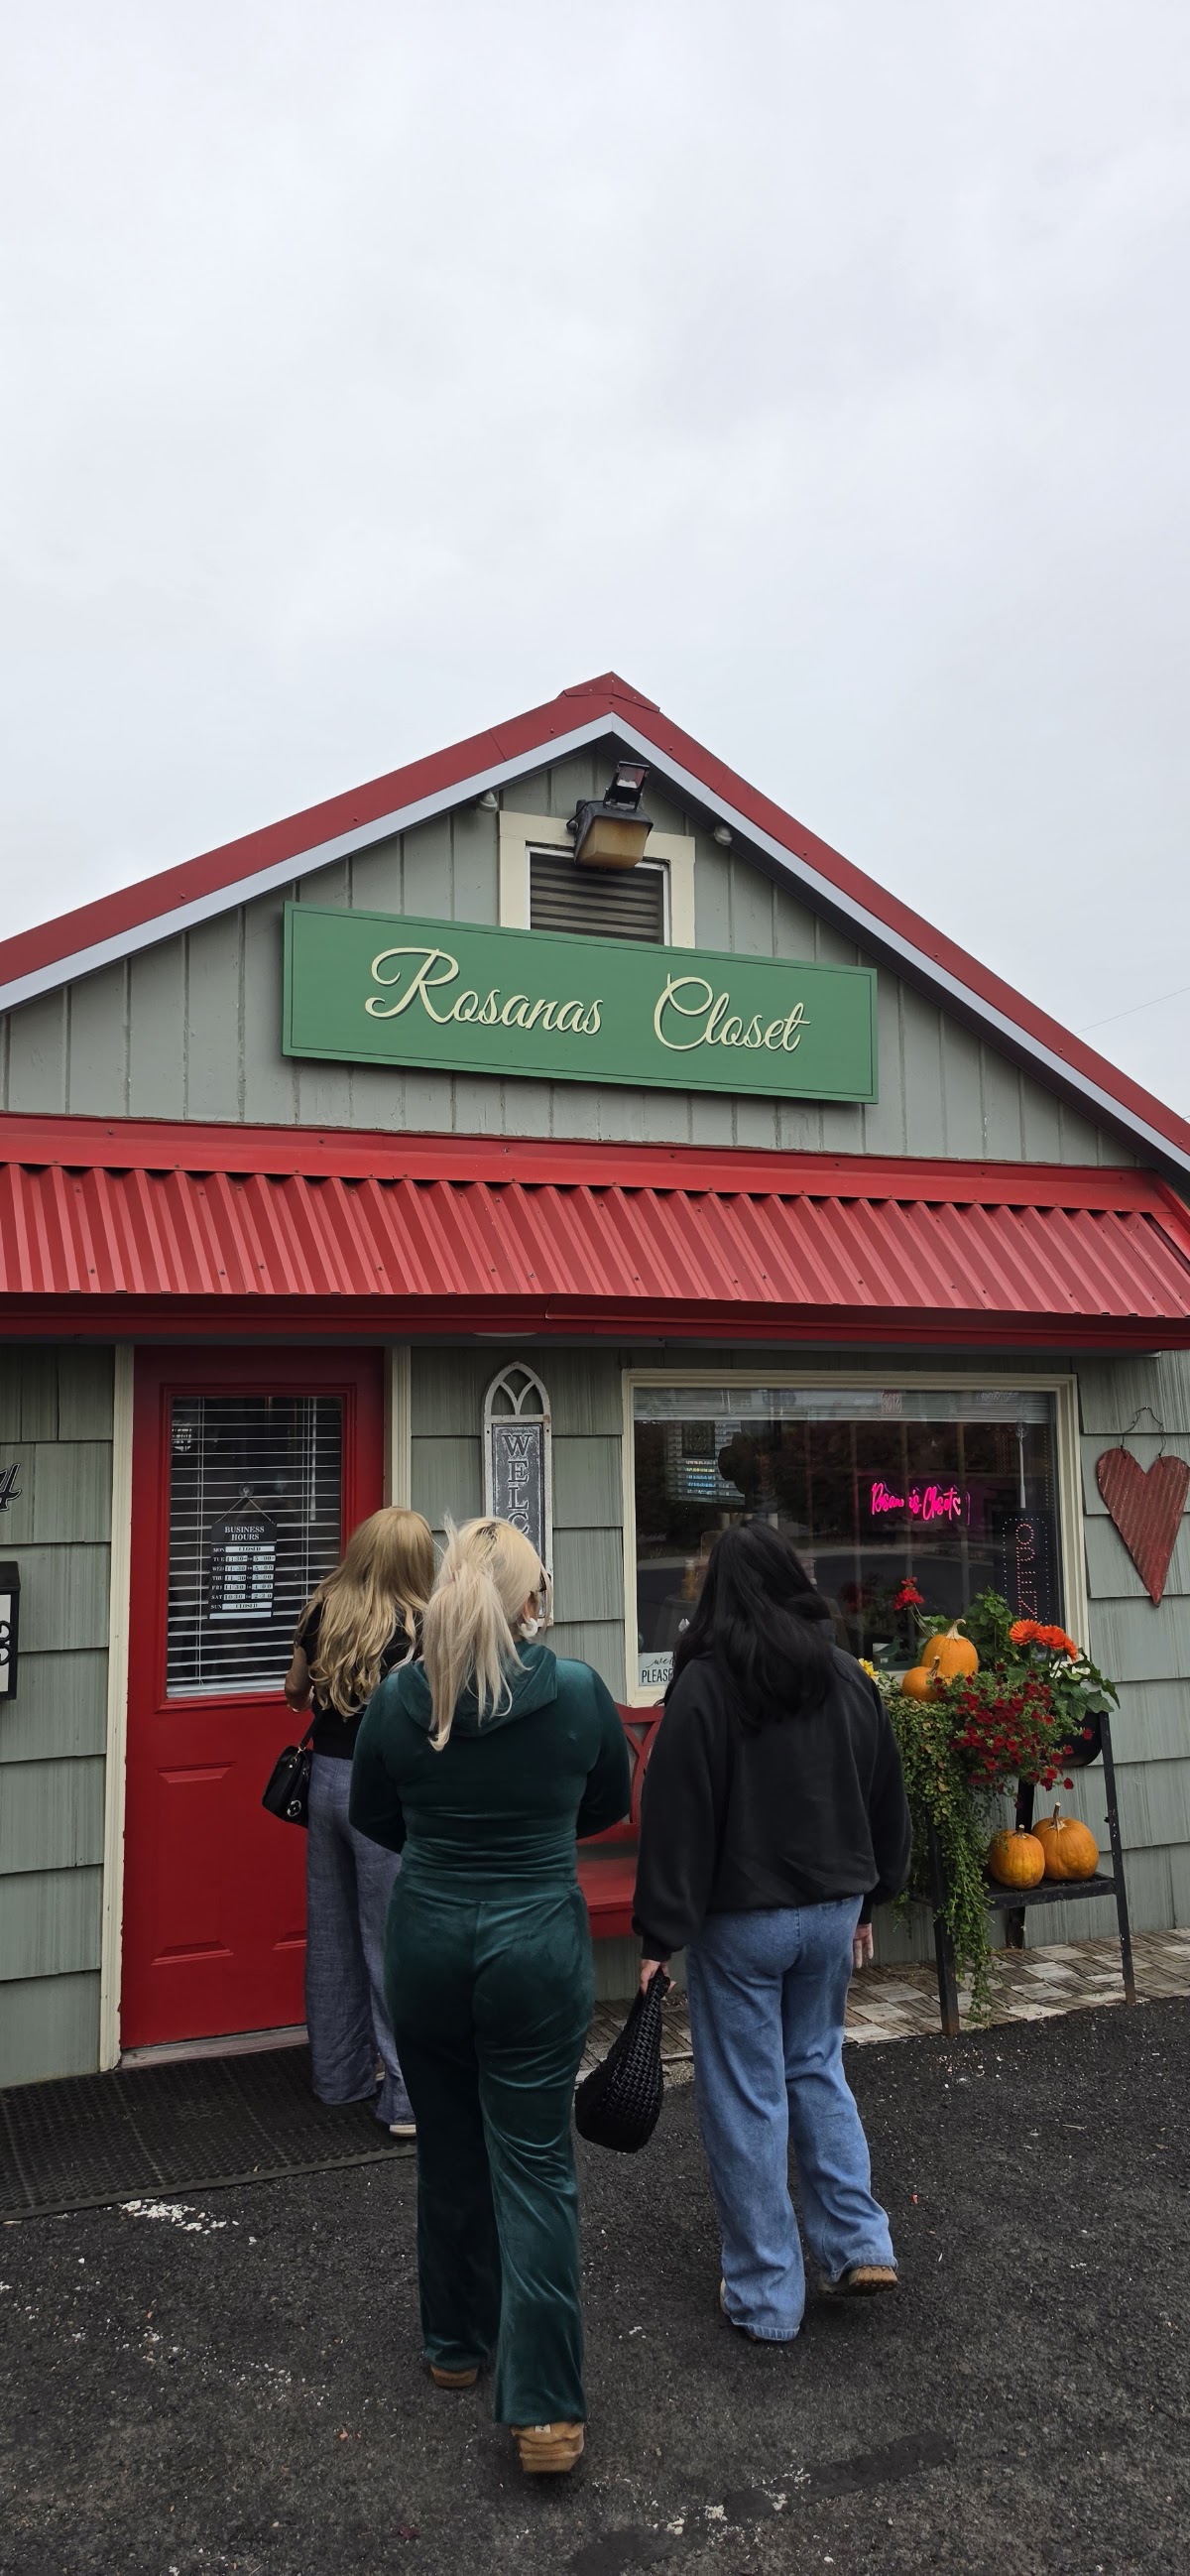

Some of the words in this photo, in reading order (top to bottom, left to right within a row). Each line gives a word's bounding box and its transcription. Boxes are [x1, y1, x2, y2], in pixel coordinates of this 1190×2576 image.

[364, 946, 604, 1036] Rosanas
[654, 973, 811, 1052] Closet
[501, 1432, 533, 1537] WELC
[1015, 1524, 1038, 1619] OPEN
